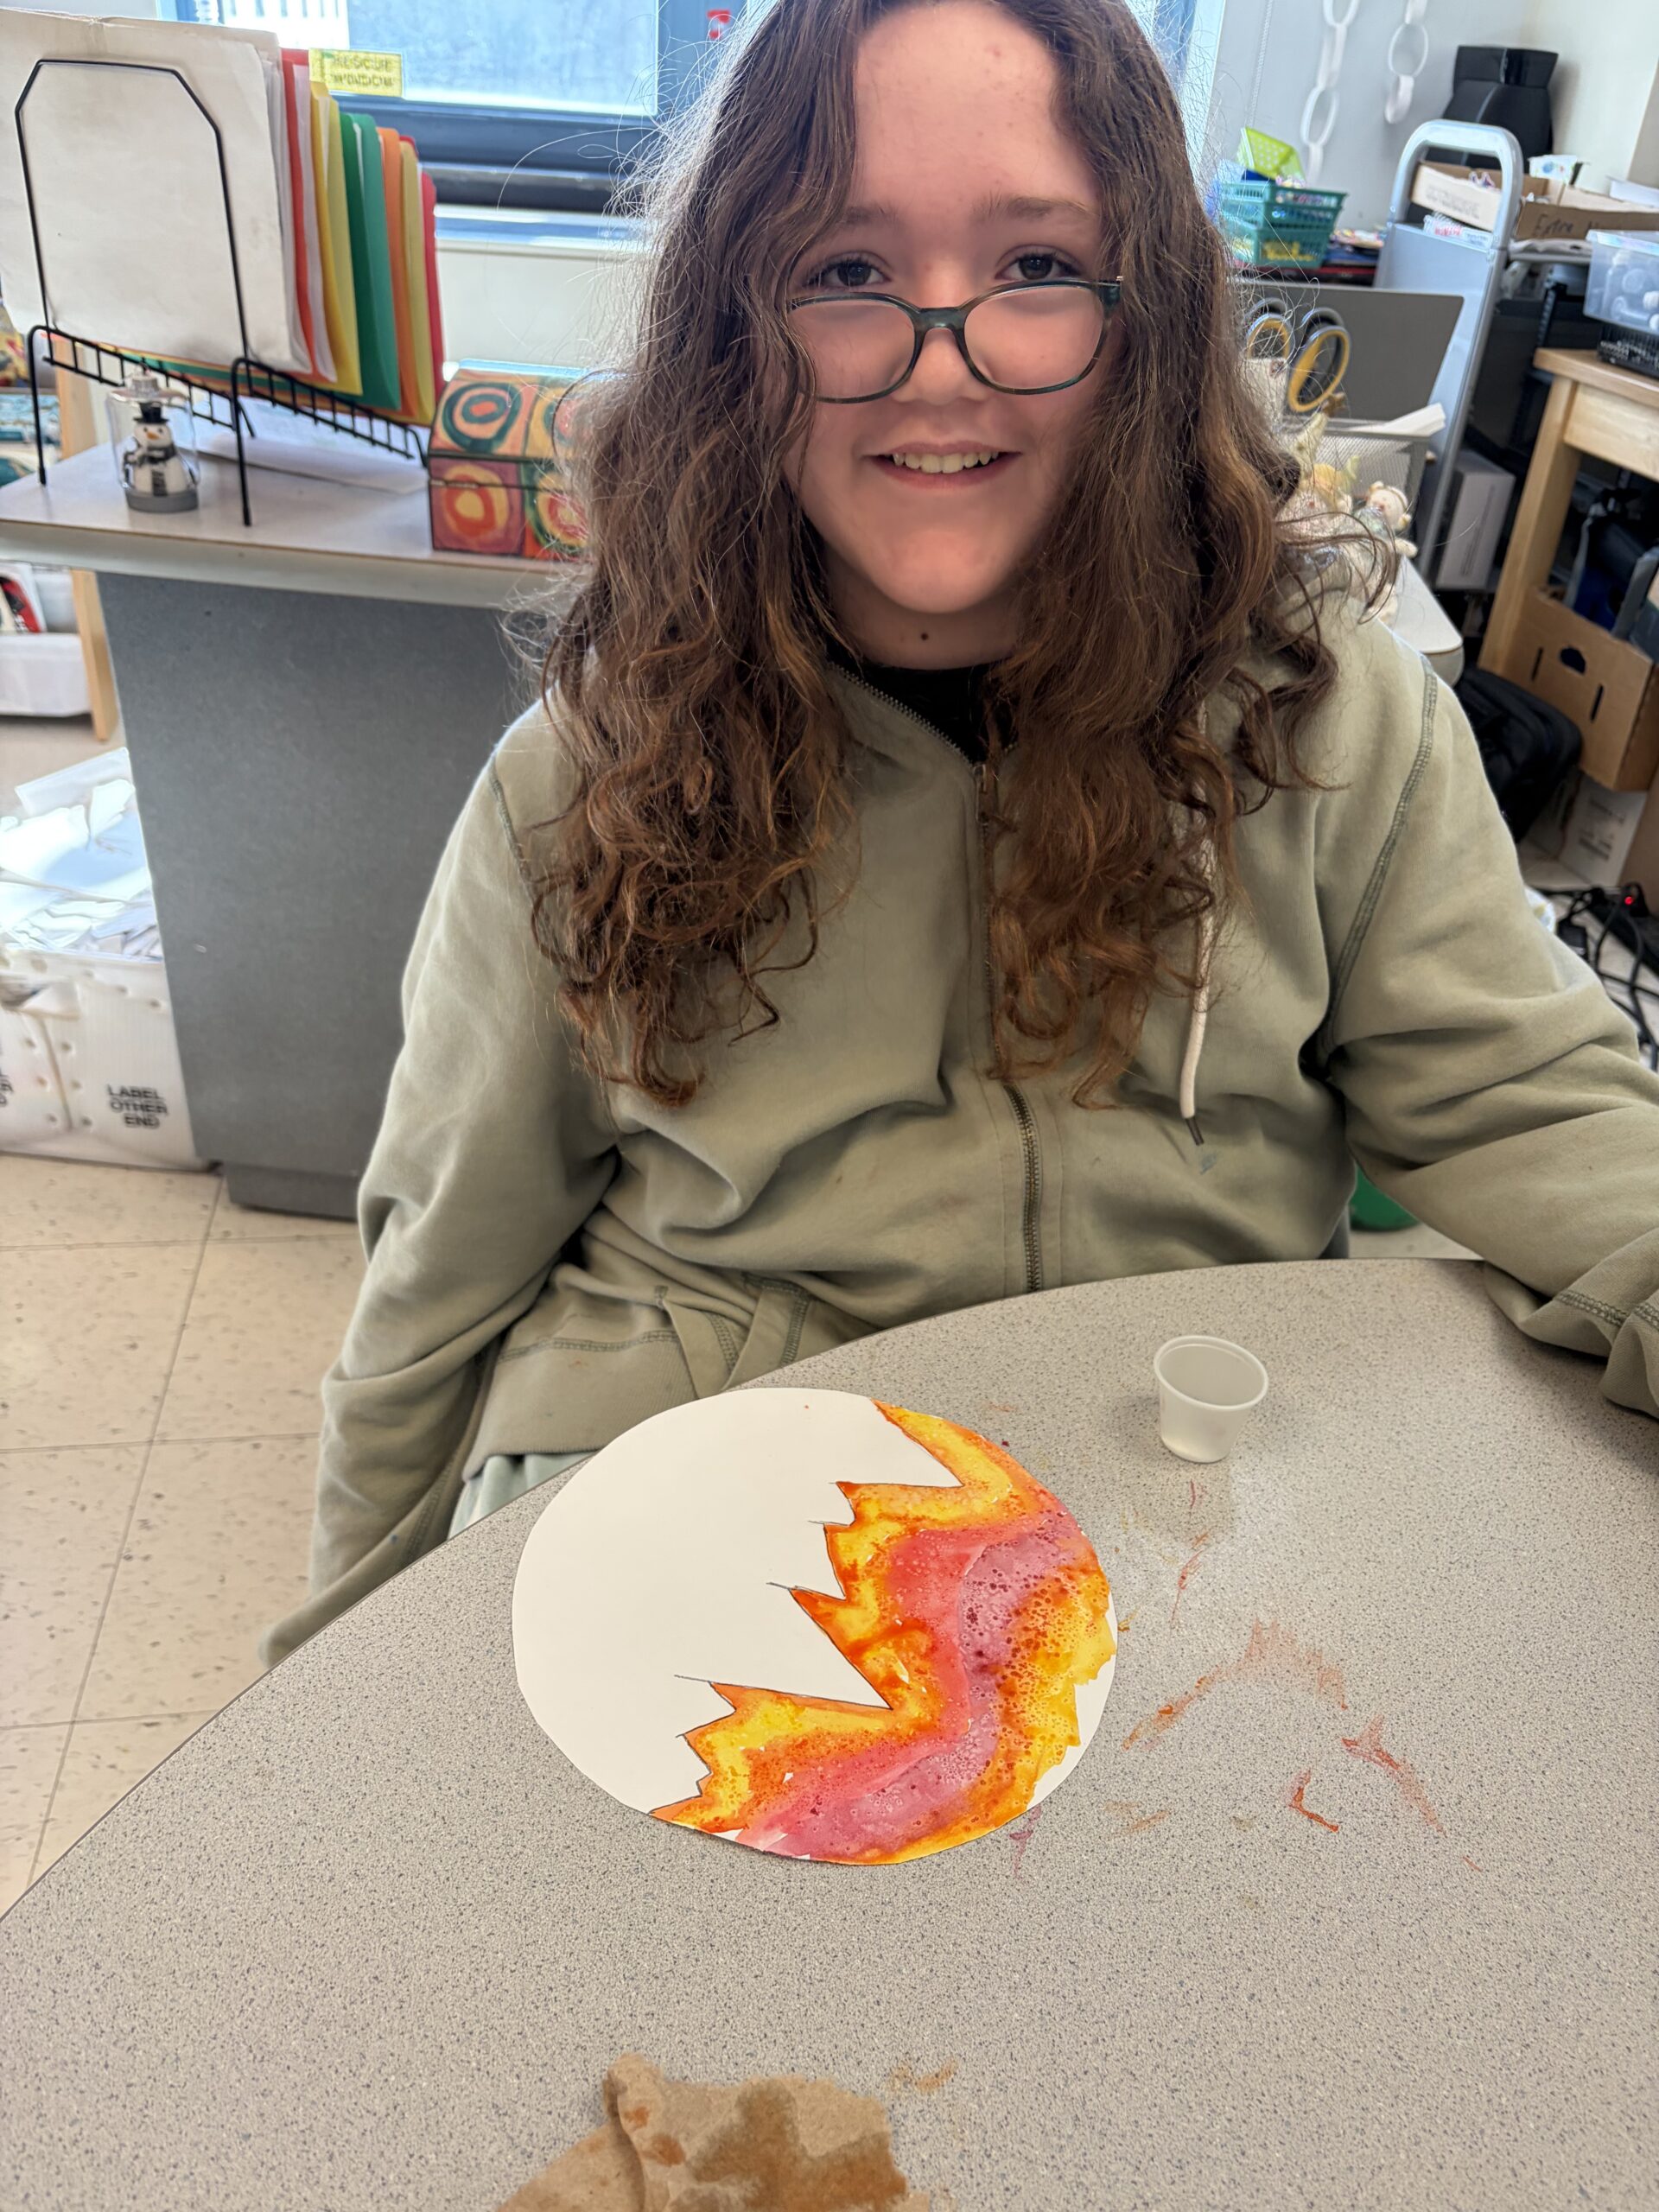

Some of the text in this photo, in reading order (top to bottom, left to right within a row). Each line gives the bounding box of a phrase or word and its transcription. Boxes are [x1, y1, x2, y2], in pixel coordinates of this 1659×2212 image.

[106, 1084, 164, 1099] LABEL
[110, 1097, 168, 1115] OTHER
[124, 1114, 160, 1128] END
